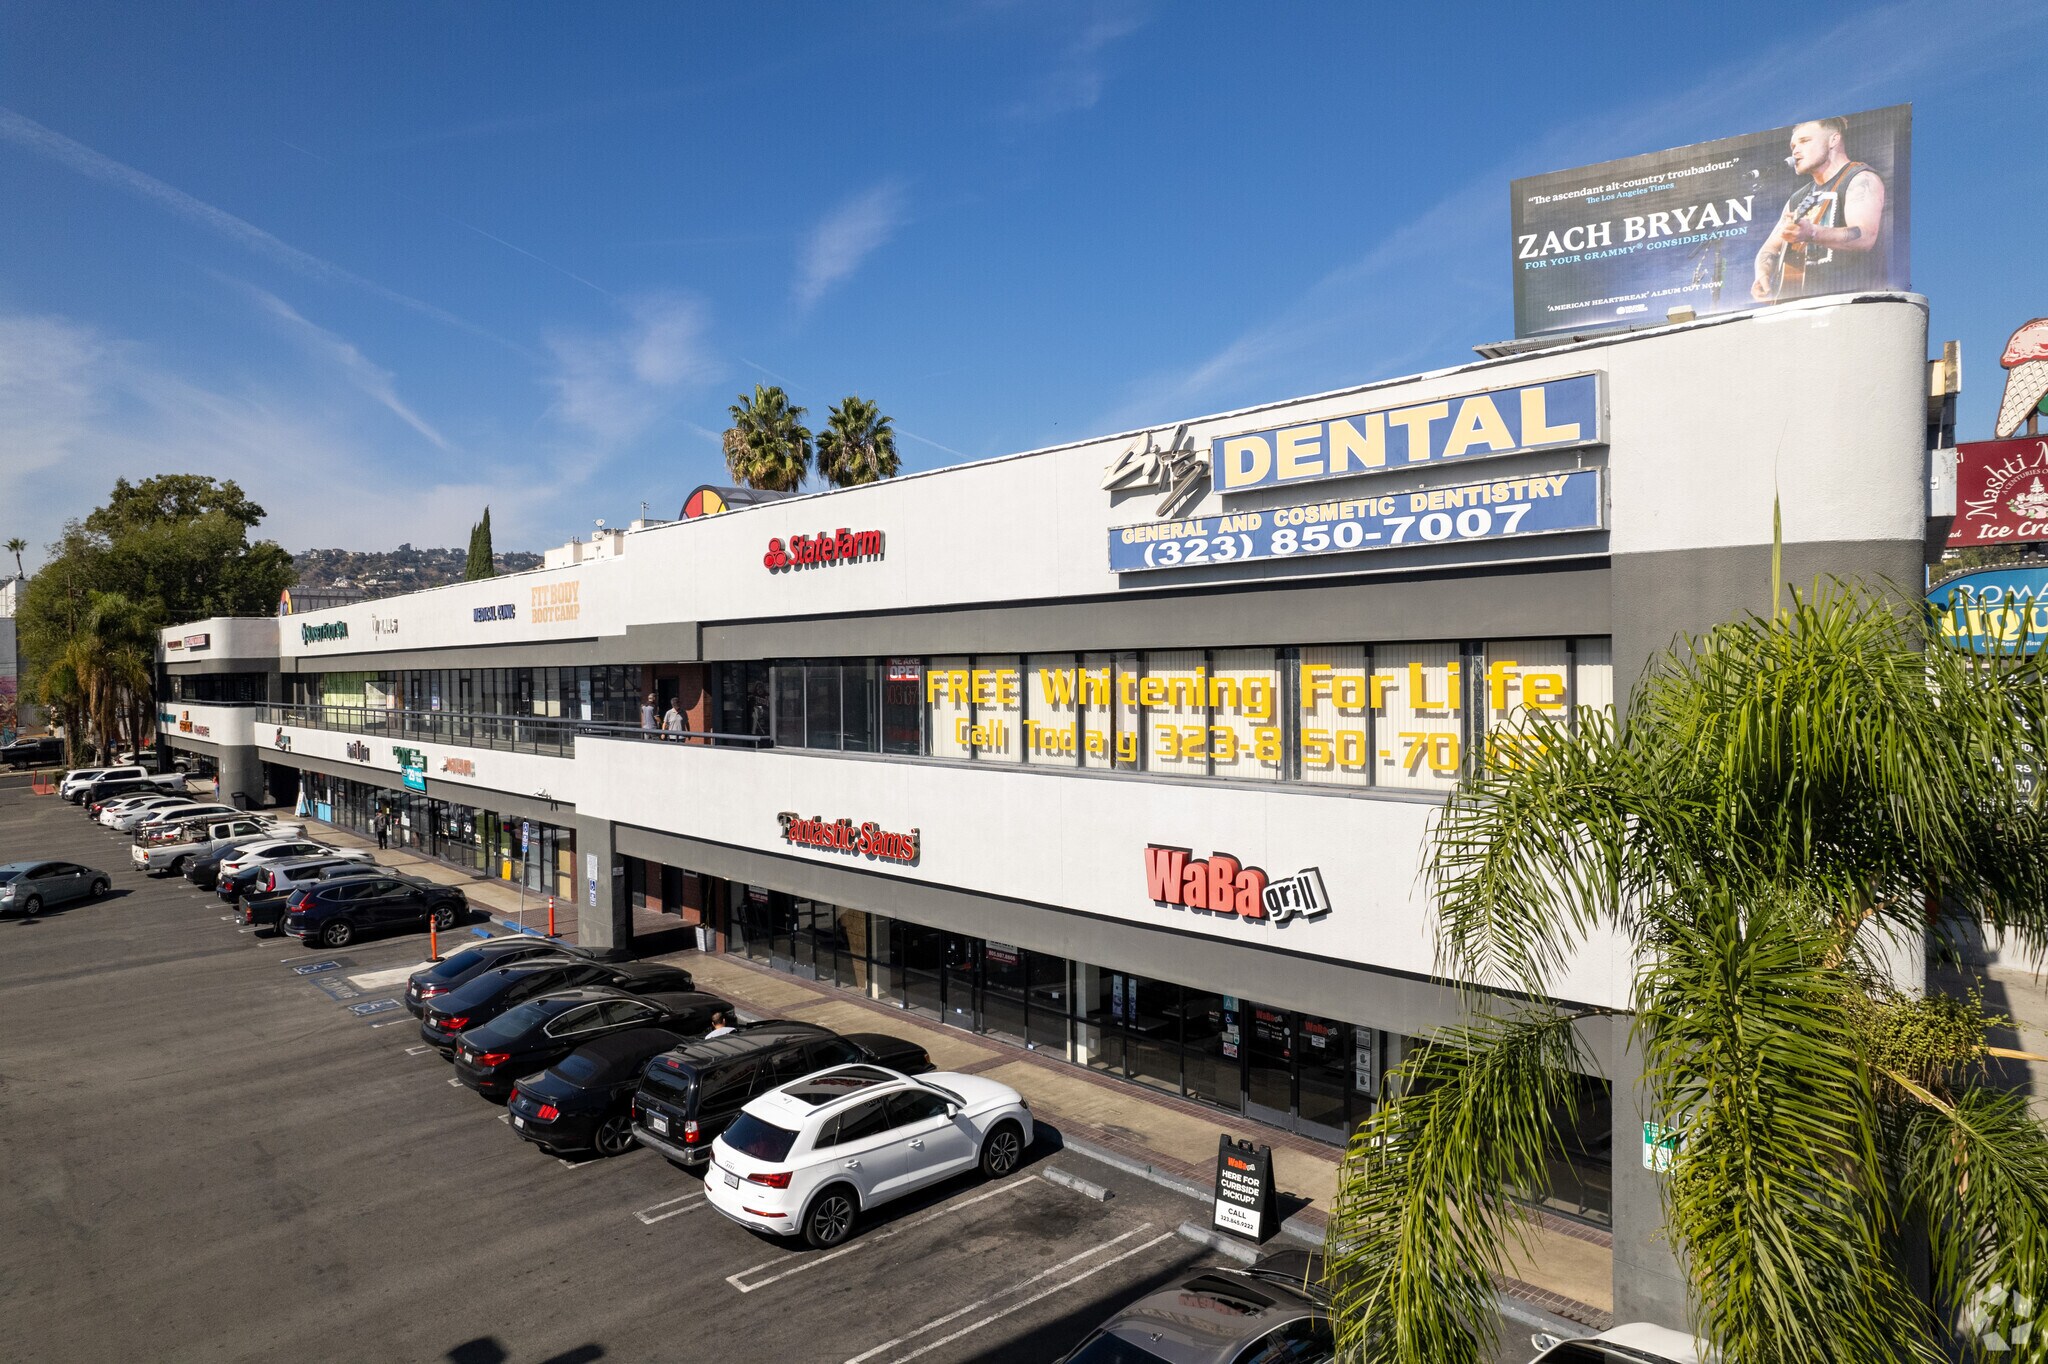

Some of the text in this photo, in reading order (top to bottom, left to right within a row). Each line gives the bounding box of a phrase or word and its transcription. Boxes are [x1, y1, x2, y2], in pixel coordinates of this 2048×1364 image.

[1552, 185, 1604, 202] ascendant
[1606, 174, 1665, 193] alt-country
[1586, 182, 1675, 204] The Los Angeles Times
[1518, 195, 1755, 260] ZACH BRYAN
[1525, 259, 1547, 270] FOR
[1550, 254, 1581, 266] YOUR
[1646, 226, 1748, 251] CONSIDERATION
[1651, 287, 1681, 298] ALBUM
[1682, 284, 1700, 293] OUT
[1701, 280, 1723, 290] NOW
[1224, 387, 1581, 489] DENTAL
[1965, 453, 2027, 520] Mashti
[2005, 468, 2041, 490] CENTURIES
[1121, 475, 1570, 546] GENERAL AND COSMETIC DENTISTRY
[1143, 502, 1533, 567] (323) 850-7007
[1977, 523, 2014, 539] Ice
[531, 580, 580, 607] FIT BODY
[473, 603, 516, 622] MEDICAL CLINIC
[927, 669, 1016, 704] FREE
[1039, 667, 1271, 719] Whitening
[1301, 664, 1395, 709] For
[955, 717, 1003, 747] Call
[1023, 719, 1137, 763] Today
[777, 811, 856, 851] Fantastic
[1144, 847, 1323, 919] WaBa grill
[1255, 1009, 1275, 1022] WaBa
[1305, 1021, 1329, 1035] WaBa
[1227, 1156, 1247, 1171] WaBa
[1221, 1178, 1260, 1197] CURBSIDE
[1222, 1169, 1260, 1187] HERE FOR
[1222, 1188, 1256, 1205] PICKUP?
[1227, 1207, 1247, 1220] CALL
